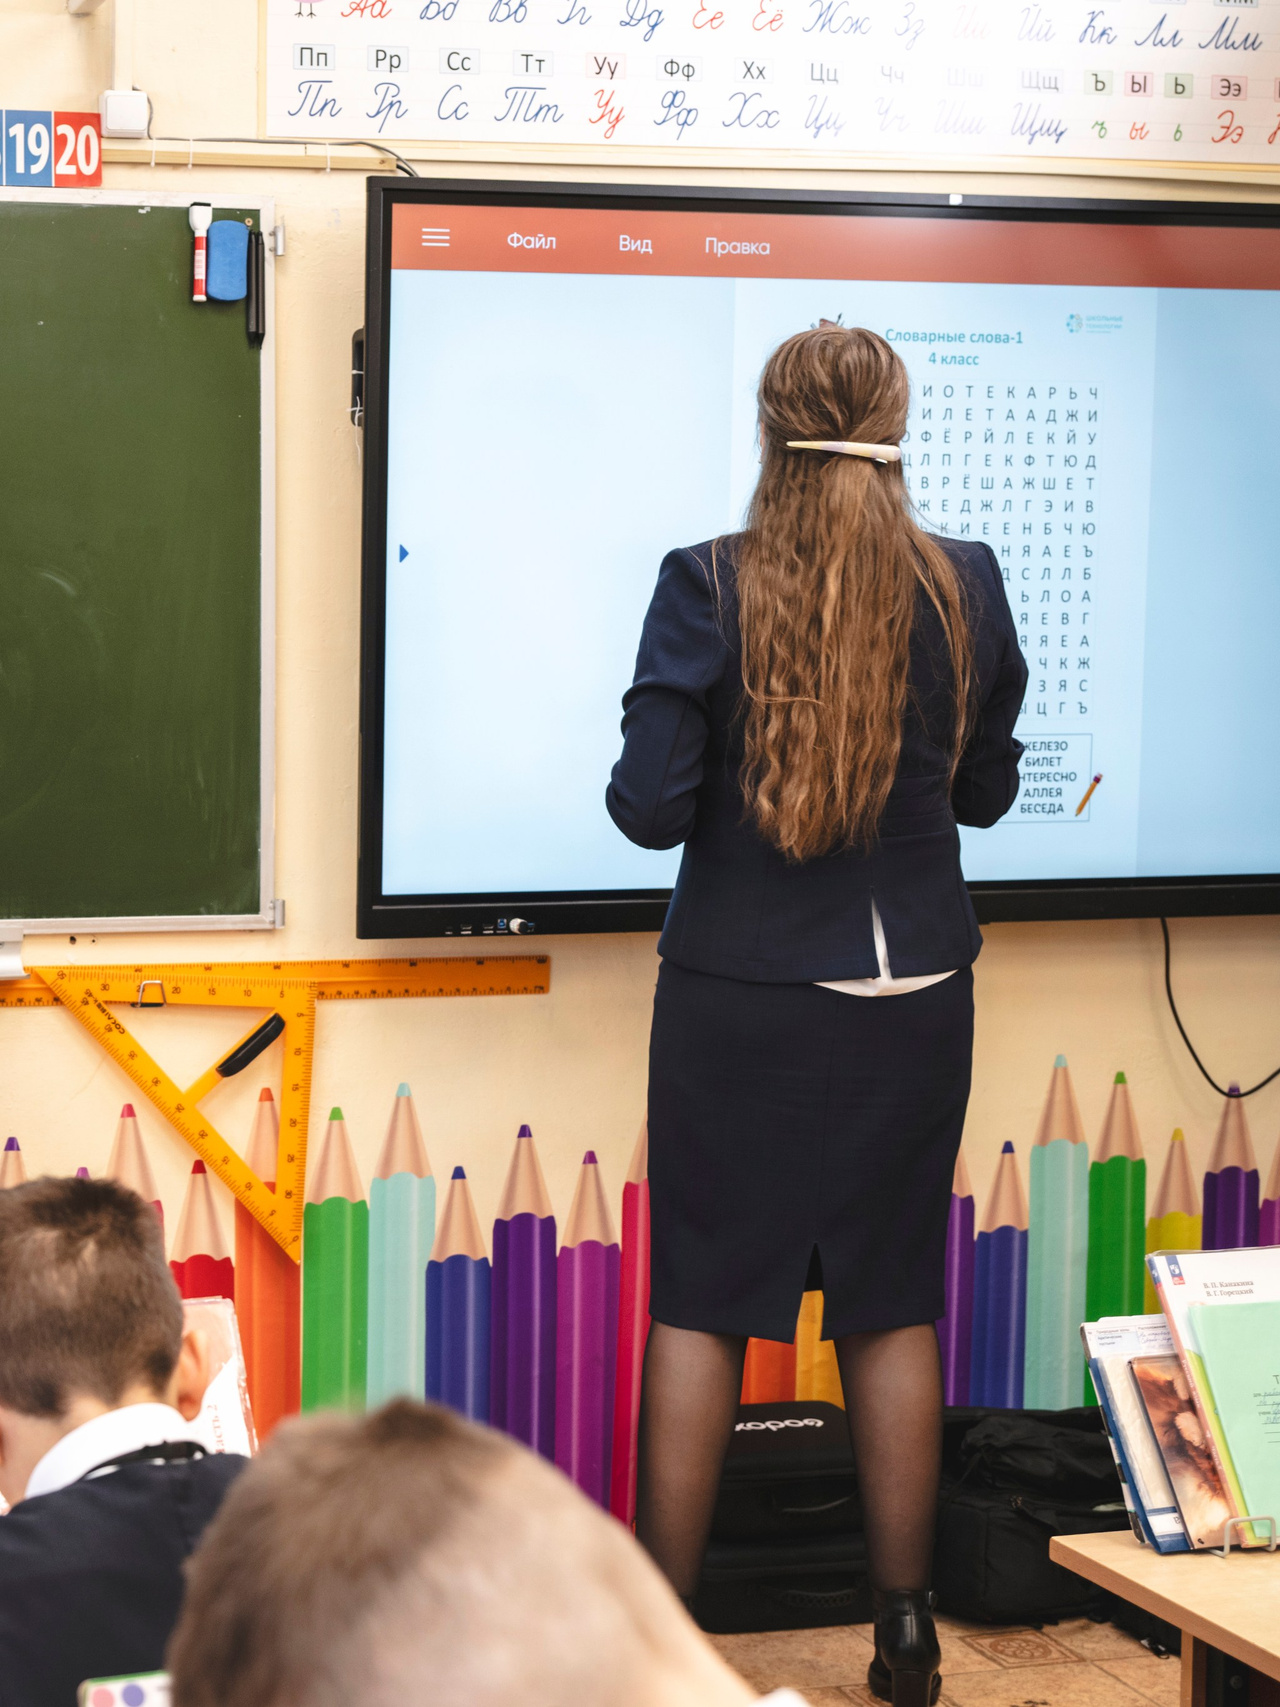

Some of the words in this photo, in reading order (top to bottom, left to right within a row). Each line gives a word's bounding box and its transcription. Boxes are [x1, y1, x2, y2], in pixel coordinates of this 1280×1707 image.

[620, 0, 664, 42] Дд
[693, 0, 725, 29] Ее
[802, 0, 872, 35] Жж
[894, 1, 926, 51] Зз
[1079, 10, 1117, 45] Кк
[1134, 12, 1184, 48] Лл
[1198, 15, 1263, 50] Мм
[300, 47, 328, 67] Пп
[375, 49, 402, 74] Рр
[446, 51, 472, 72] Сс
[521, 54, 546, 73] Тт
[594, 56, 619, 80] Уу
[663, 58, 695, 82] Фф
[742, 60, 766, 81] Хх
[810, 62, 839, 85] Цц
[1021, 70, 1059, 93] Щщ
[1219, 78, 1242, 97] Ээ
[288, 80, 342, 118] Пп
[366, 82, 408, 133] Рр
[437, 84, 469, 121] Сс
[494, 86, 564, 123] Тт
[589, 88, 625, 139] Уу
[653, 89, 699, 141] Фф
[722, 92, 780, 128] Хх
[804, 94, 846, 139] Цц
[1011, 102, 1067, 145] Щщ
[1211, 109, 1244, 144] Ээ
[8, 122, 51, 175] 19
[55, 124, 99, 176] 20
[507, 231, 557, 250] Файл
[619, 234, 653, 254] Вид
[705, 237, 771, 257] Правка
[885, 328, 966, 345] Словарные
[969, 331, 1024, 345] слова-1
[928, 352, 937, 365] 4
[940, 352, 980, 366] класс
[1025, 757, 1062, 767] БИЛЕТ
[1019, 771, 1077, 783] НТЕРЕСНО
[1023, 787, 1063, 798] АЛЛЕЯ
[1020, 803, 1064, 815] БЕСЕДА
[101, 983, 110, 992] 30
[172, 986, 181, 995] 20
[208, 988, 216, 996] 15
[244, 989, 252, 997] 10
[294, 1047, 301, 1056] 10
[57, 969, 66, 980] 50
[80, 997, 90, 1006] 45
[104, 1023, 114, 1034] 40
[127, 1050, 138, 1061] 35
[151, 1077, 161, 1087] 30
[174, 1103, 185, 1113] 25
[198, 1129, 208, 1140] 20
[221, 1156, 230, 1165] 15
[245, 1182, 254, 1192] 10
[269, 1209, 277, 1217] 5
[291, 1083, 299, 1092] 15
[289, 1118, 297, 1128] 20
[286, 1153, 295, 1163] 25
[284, 1189, 293, 1199] 30
